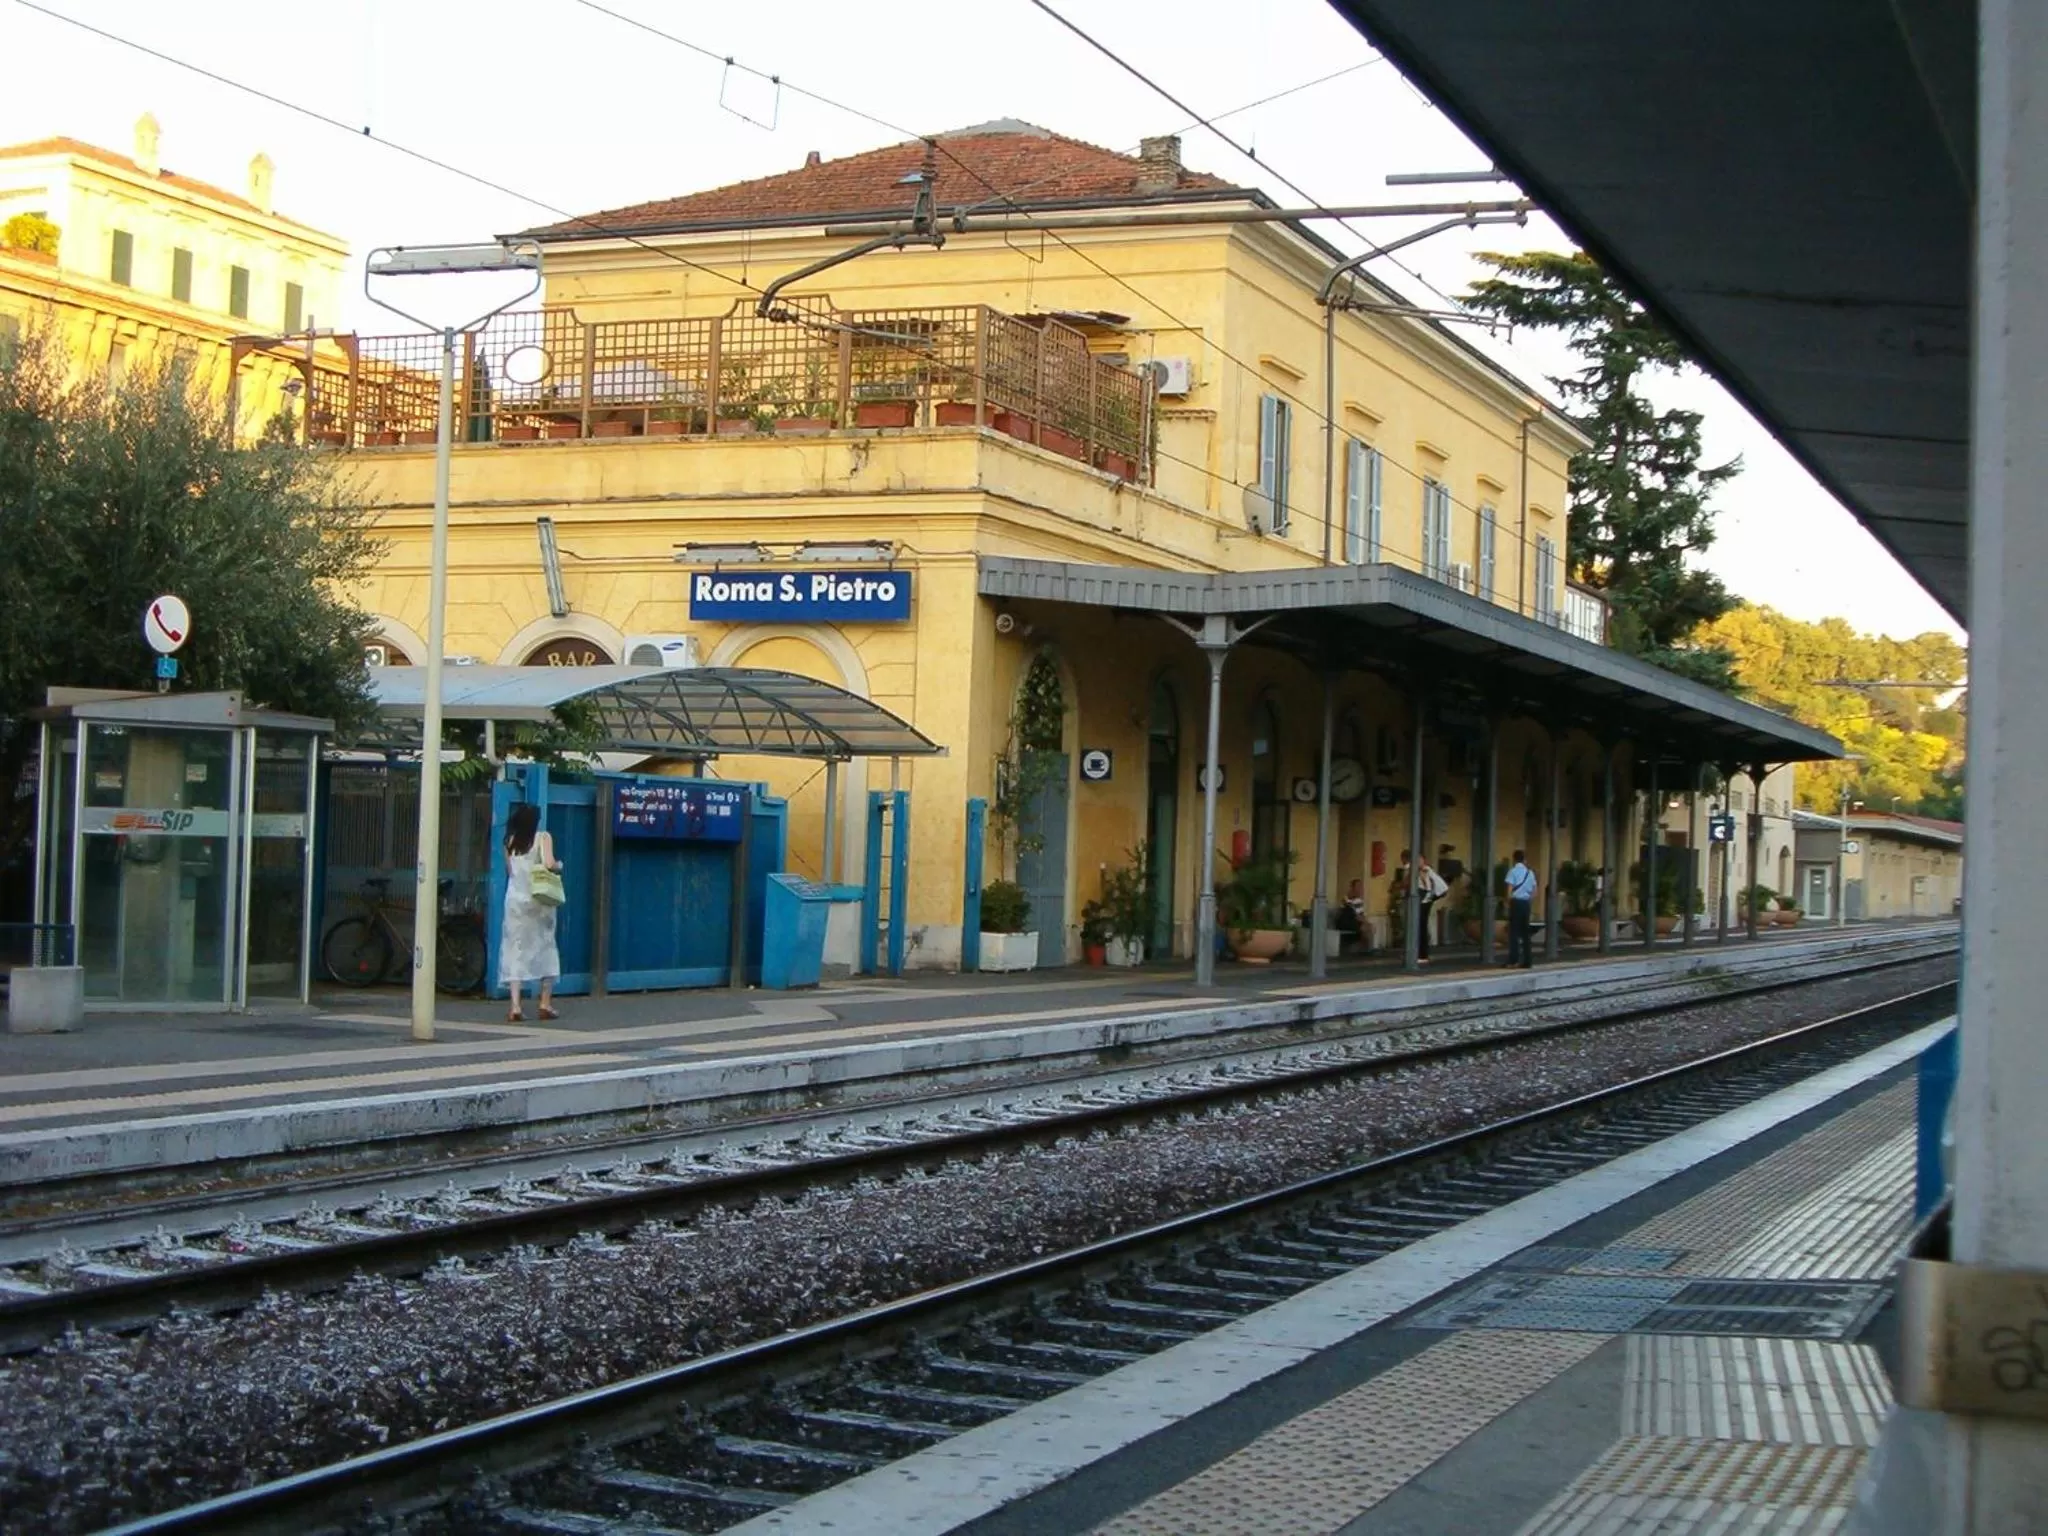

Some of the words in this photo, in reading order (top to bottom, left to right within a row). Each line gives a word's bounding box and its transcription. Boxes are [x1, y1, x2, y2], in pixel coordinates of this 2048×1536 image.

[696, 574, 773, 602] Roma
[780, 574, 804, 602] S.
[811, 574, 896, 602] Pietro
[548, 651, 596, 667] BAR
